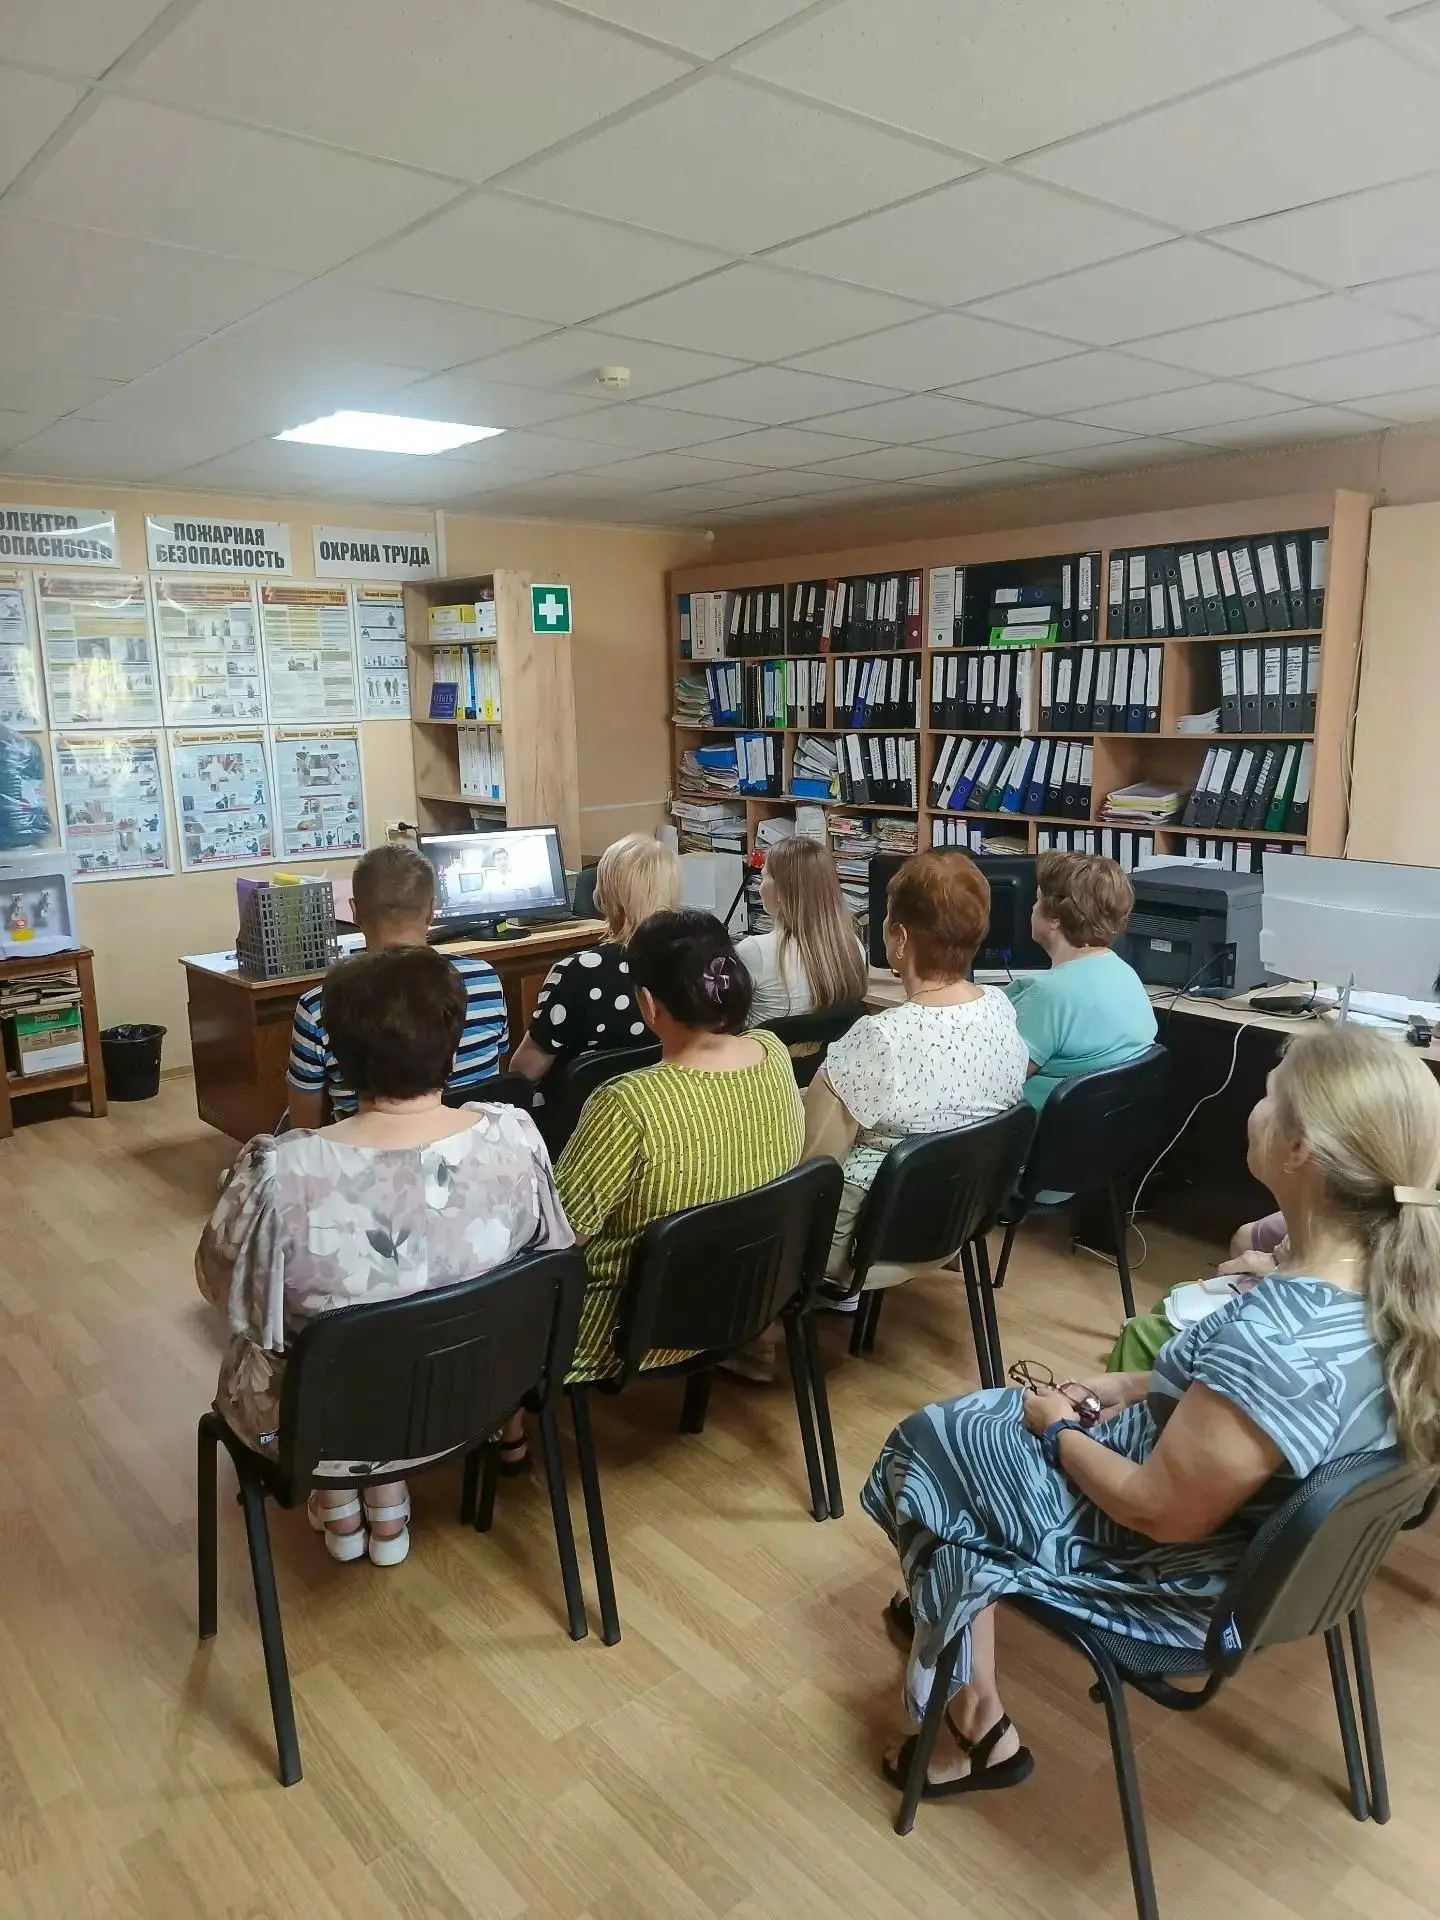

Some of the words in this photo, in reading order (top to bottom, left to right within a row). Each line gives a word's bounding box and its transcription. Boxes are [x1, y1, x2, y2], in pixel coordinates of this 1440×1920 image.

[174, 522, 266, 546] ПОЖАРНАЯ
[156, 543, 286, 568] БЕЗОПАСНОСТЬ
[319, 540, 381, 563] ОХРАНА
[382, 544, 431, 567] ТРУДА
